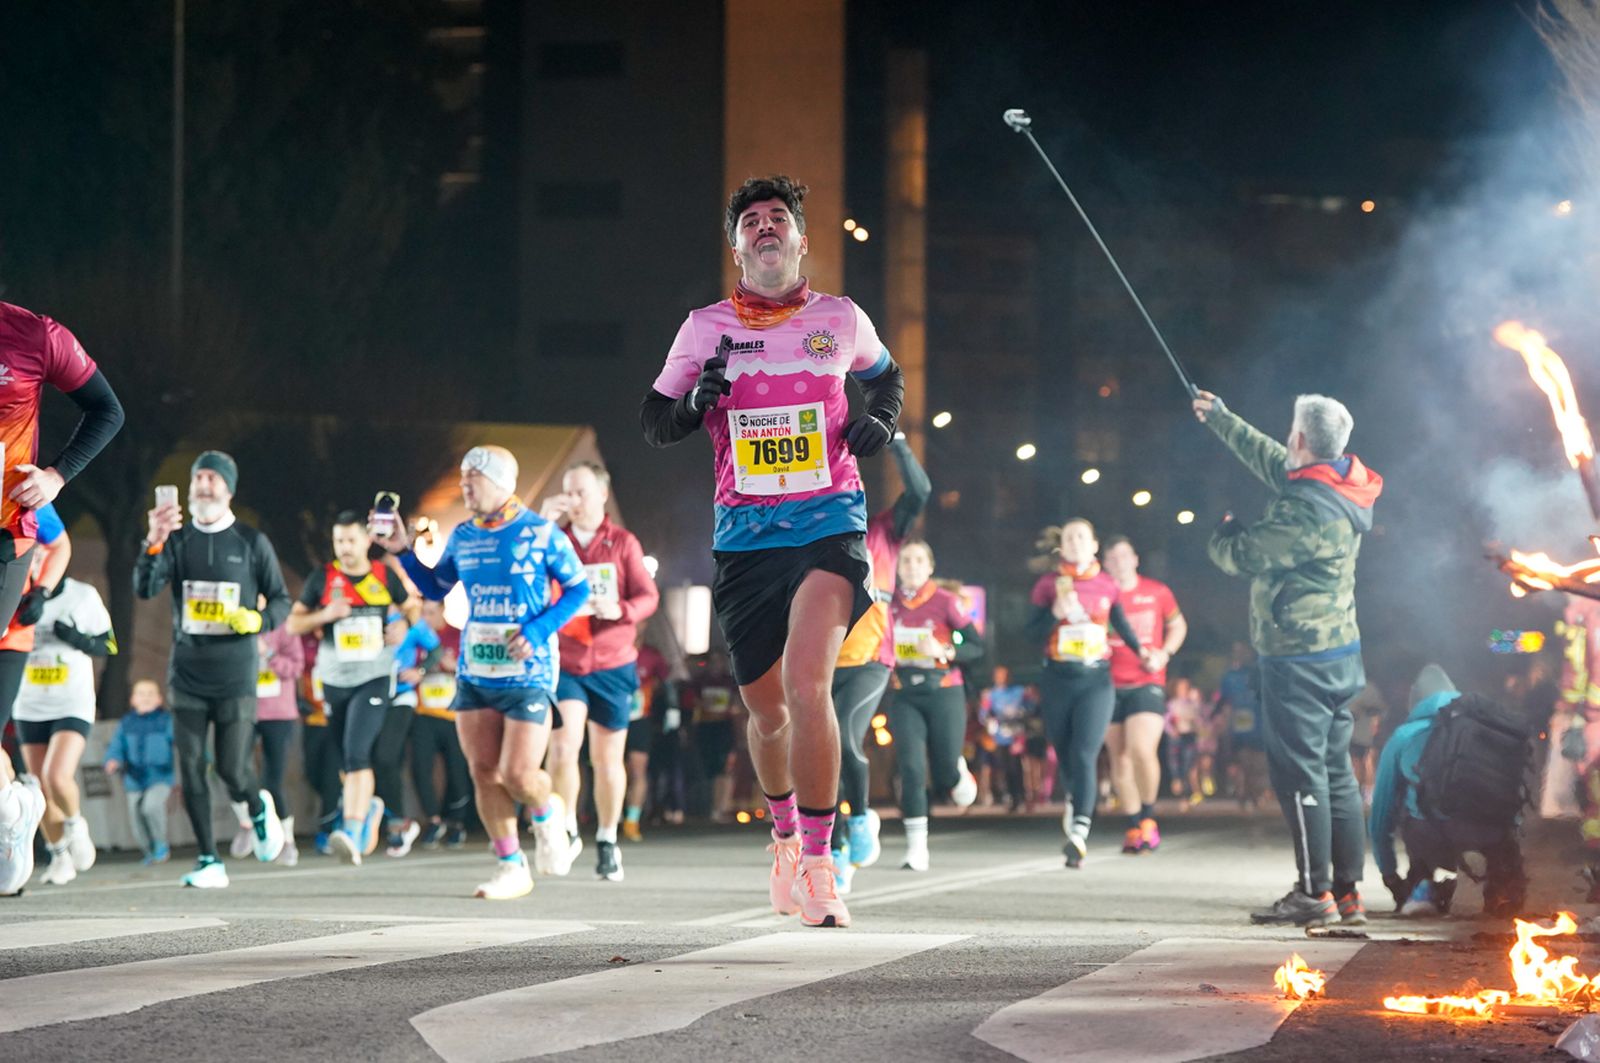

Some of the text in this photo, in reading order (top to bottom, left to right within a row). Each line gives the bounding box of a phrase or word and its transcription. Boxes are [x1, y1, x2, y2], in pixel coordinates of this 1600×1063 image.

[715, 340, 765, 355] IARABLES
[750, 416, 777, 427] NOCHE
[780, 415, 790, 424] DE
[741, 428, 758, 438] SAN
[760, 424, 791, 438] ANTÓN
[749, 436, 810, 465] 7699
